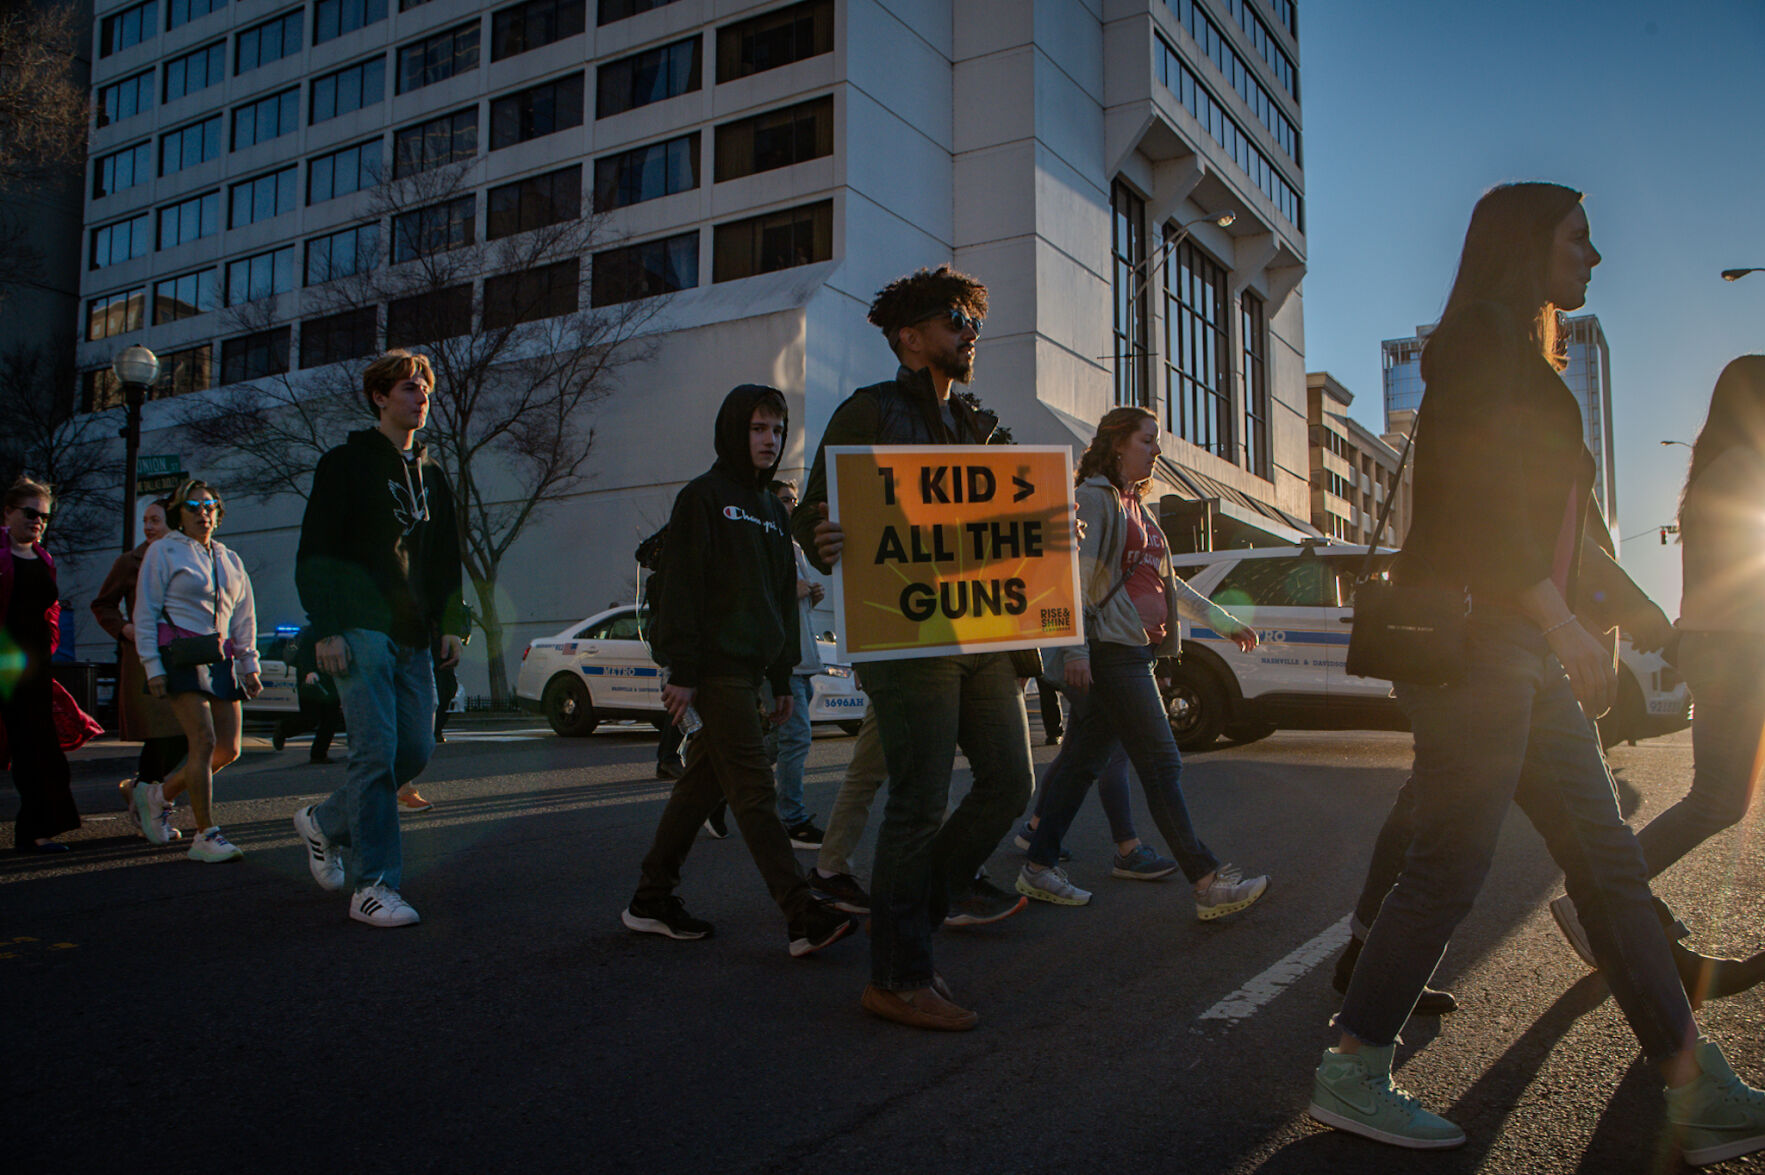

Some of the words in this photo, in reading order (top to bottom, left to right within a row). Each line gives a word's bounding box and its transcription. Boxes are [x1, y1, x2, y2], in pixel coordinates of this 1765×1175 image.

[879, 467, 896, 505] 1
[921, 466, 996, 504] KID
[874, 524, 954, 565] ALL
[966, 521, 1044, 560] THE
[899, 578, 1027, 622] GUNS
[1041, 617, 1071, 627] SHINE
[603, 667, 635, 676] METRO
